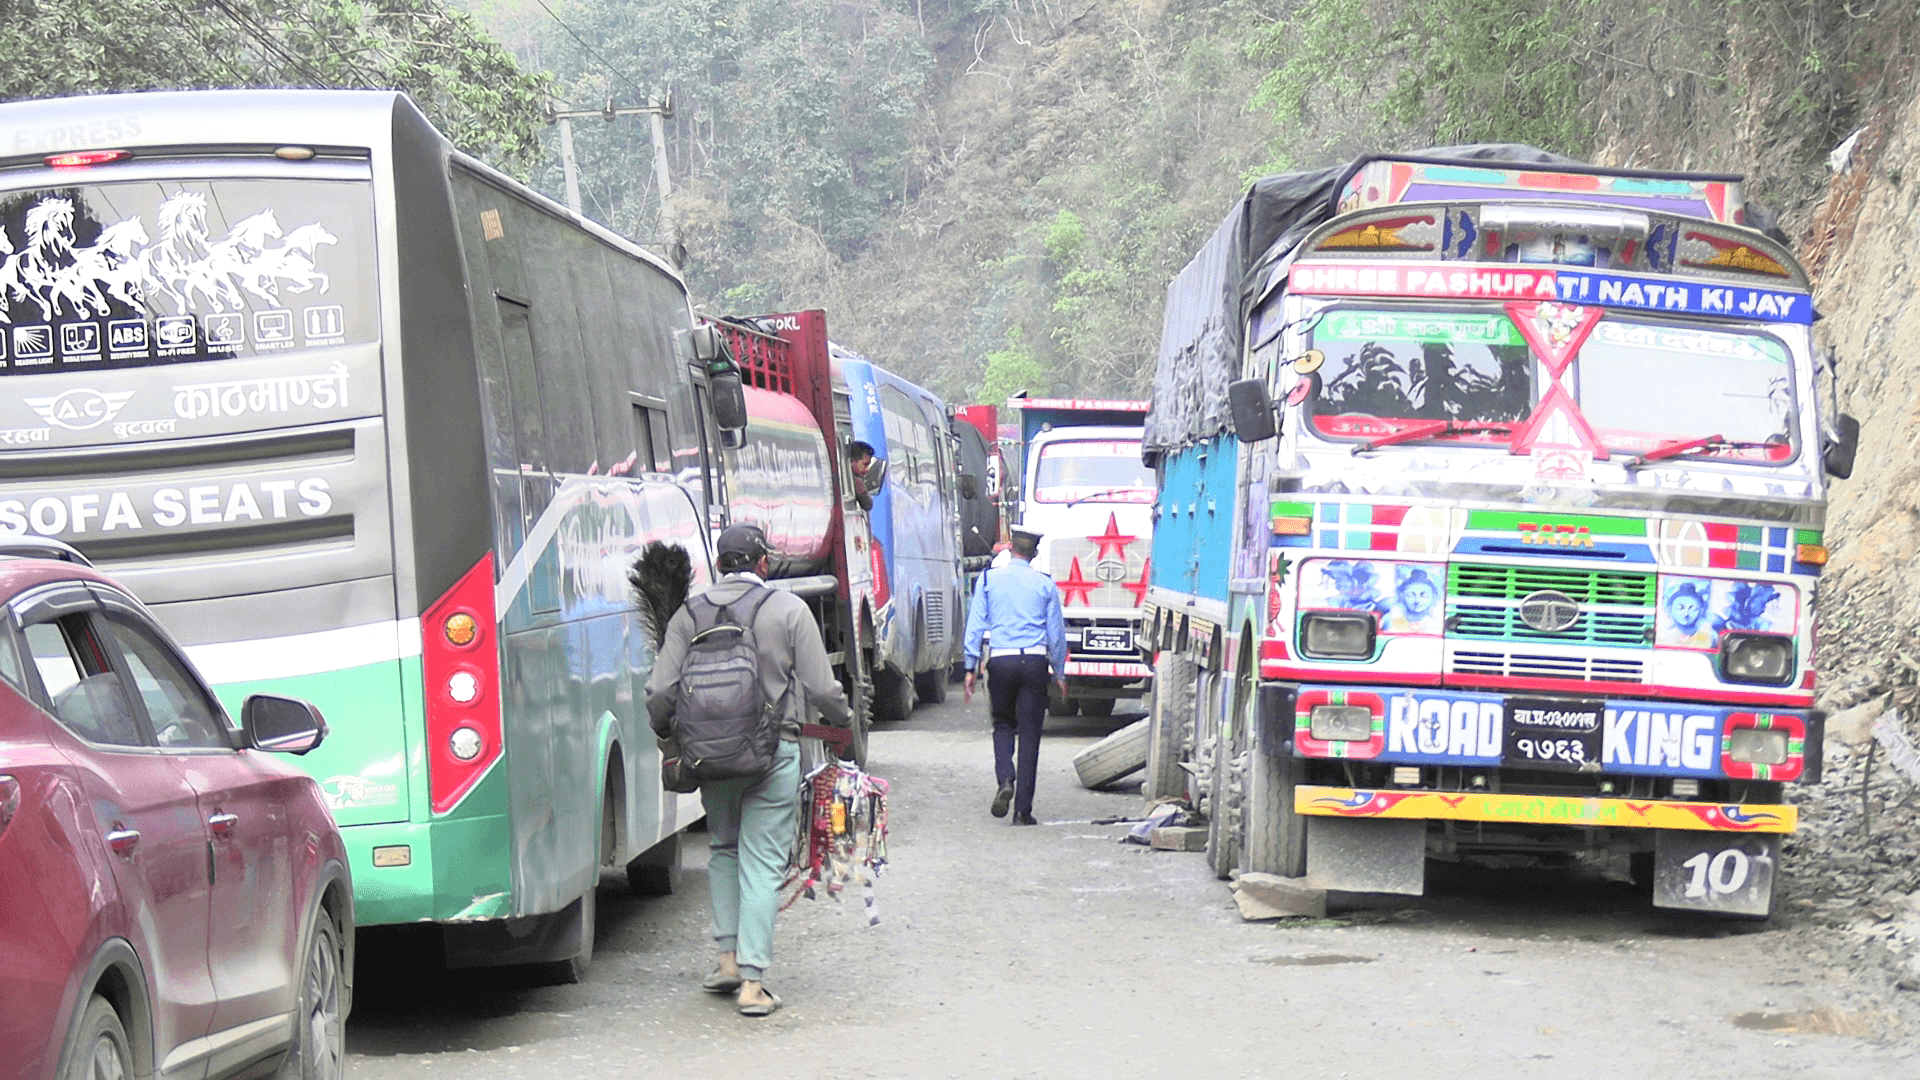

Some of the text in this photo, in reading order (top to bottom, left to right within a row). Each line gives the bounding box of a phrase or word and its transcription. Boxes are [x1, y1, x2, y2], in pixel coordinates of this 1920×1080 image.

[13, 114, 142, 152] EXPRESS
[1294, 269, 1796, 318] SHREE PASHUPATI NATH KI JAY
[113, 326, 144, 345] ABS
[207, 343, 244, 354] MUSIC
[0, 477, 333, 537] SOFA SEATS
[1517, 522, 1595, 548] TATA
[1388, 696, 1716, 771] ROAD KING
[1517, 739, 1587, 767] १७६३
[1682, 848, 1749, 898] 10
